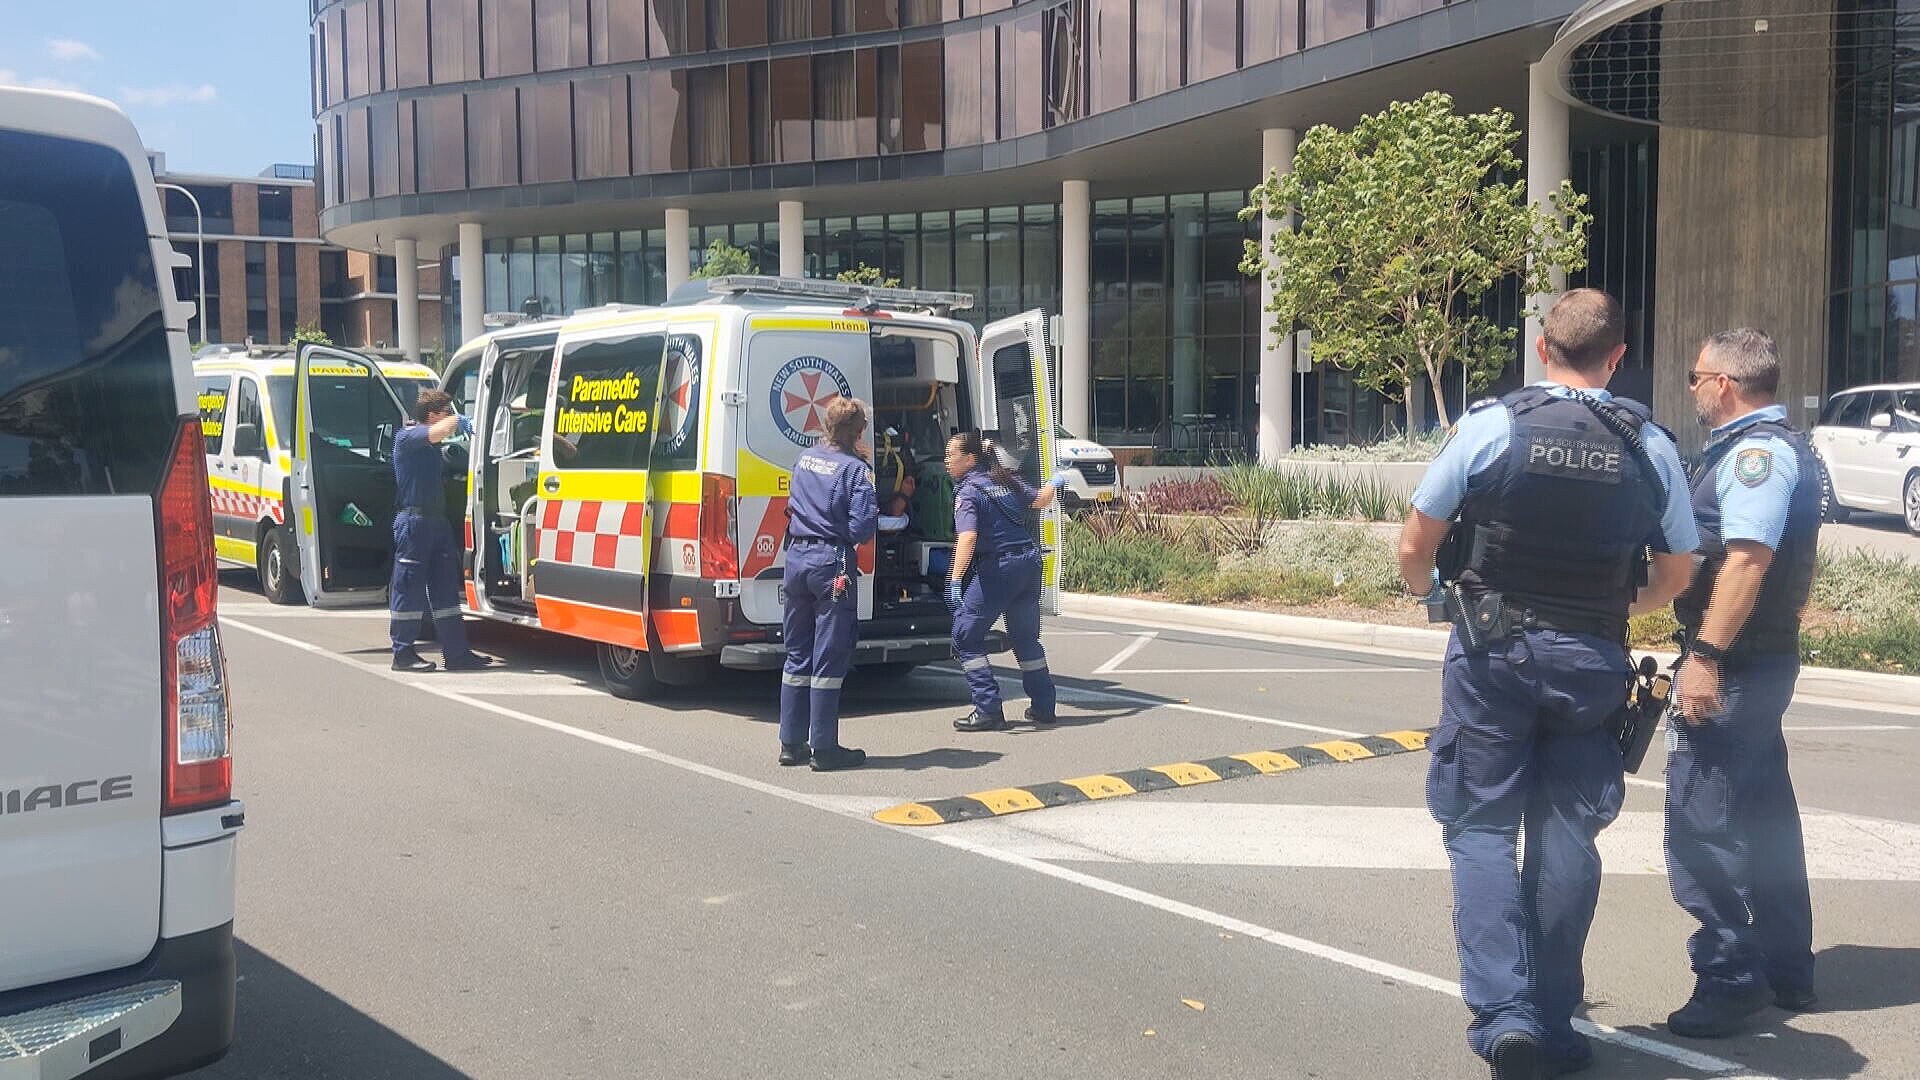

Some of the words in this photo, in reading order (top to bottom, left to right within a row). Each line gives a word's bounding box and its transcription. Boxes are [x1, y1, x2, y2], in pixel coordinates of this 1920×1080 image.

[684, 341, 699, 385] WALES
[772, 366, 789, 393] NEW
[790, 358, 823, 371] SOUTH
[824, 362, 850, 397] WALES
[571, 371, 640, 402] Paramedic
[557, 405, 612, 433] Intensive
[615, 404, 647, 433] Care
[784, 427, 816, 448] AMBU
[1529, 444, 1620, 473] POLICE
[757, 543, 775, 552] 000
[0, 775, 133, 815] IACE
